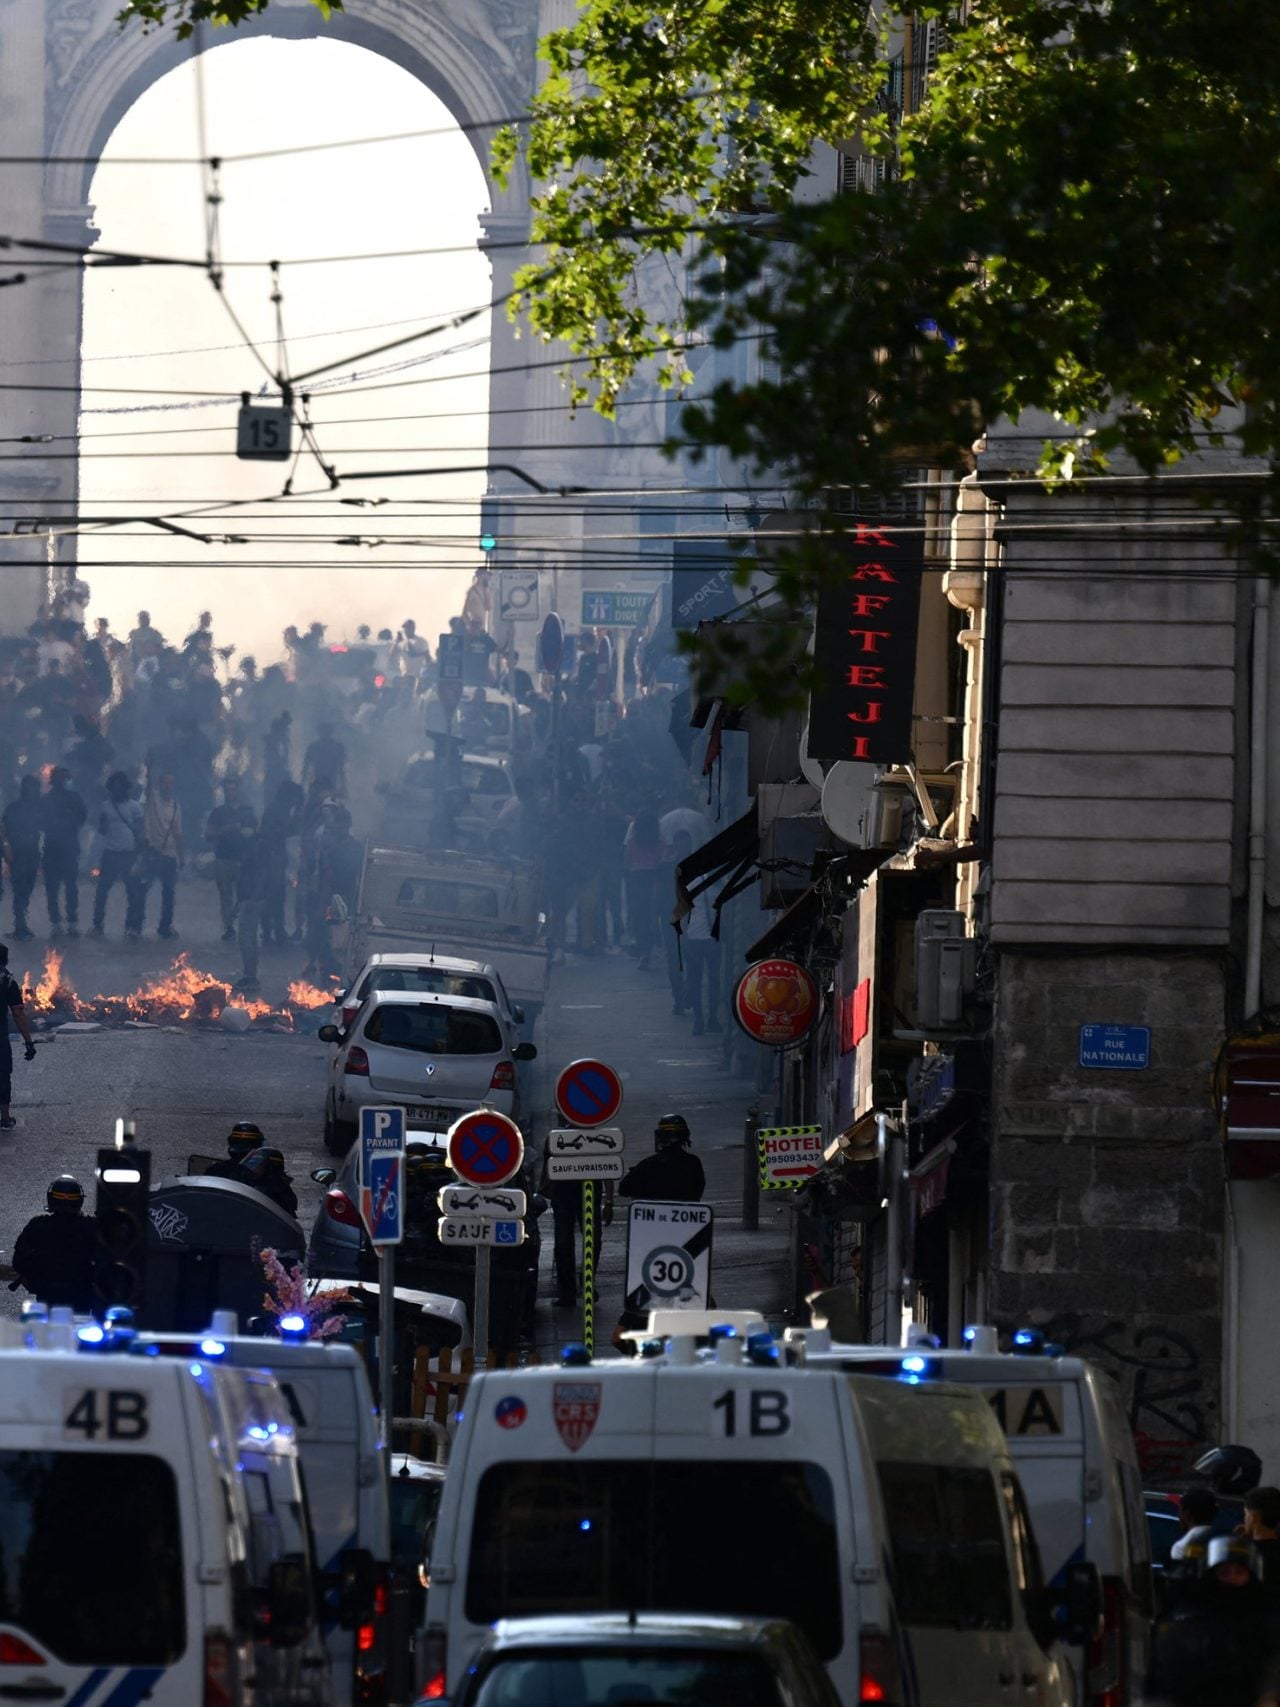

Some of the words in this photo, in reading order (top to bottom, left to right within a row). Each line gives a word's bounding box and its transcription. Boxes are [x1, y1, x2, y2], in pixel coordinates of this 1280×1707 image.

[250, 419, 279, 448] 15
[678, 577, 719, 616] SPORT
[846, 521, 901, 759] KAFTEJI
[1104, 1040, 1126, 1049] RUE
[1083, 1051, 1146, 1062] NATIONALE
[375, 1112, 392, 1138] P
[366, 1138, 399, 1148] PAYANT
[765, 1137, 822, 1153] HOTEL
[552, 1165, 573, 1173] SAUF
[574, 1163, 619, 1173] LIVRAISONS
[634, 1208, 655, 1221] FIN
[671, 1210, 707, 1223] ZONE
[447, 1224, 491, 1239] SAUF
[653, 1260, 683, 1283] 30
[66, 1390, 149, 1440] 4B
[557, 1403, 597, 1422] CRS
[714, 1389, 791, 1437] 1B
[989, 1388, 1062, 1435] 1A
